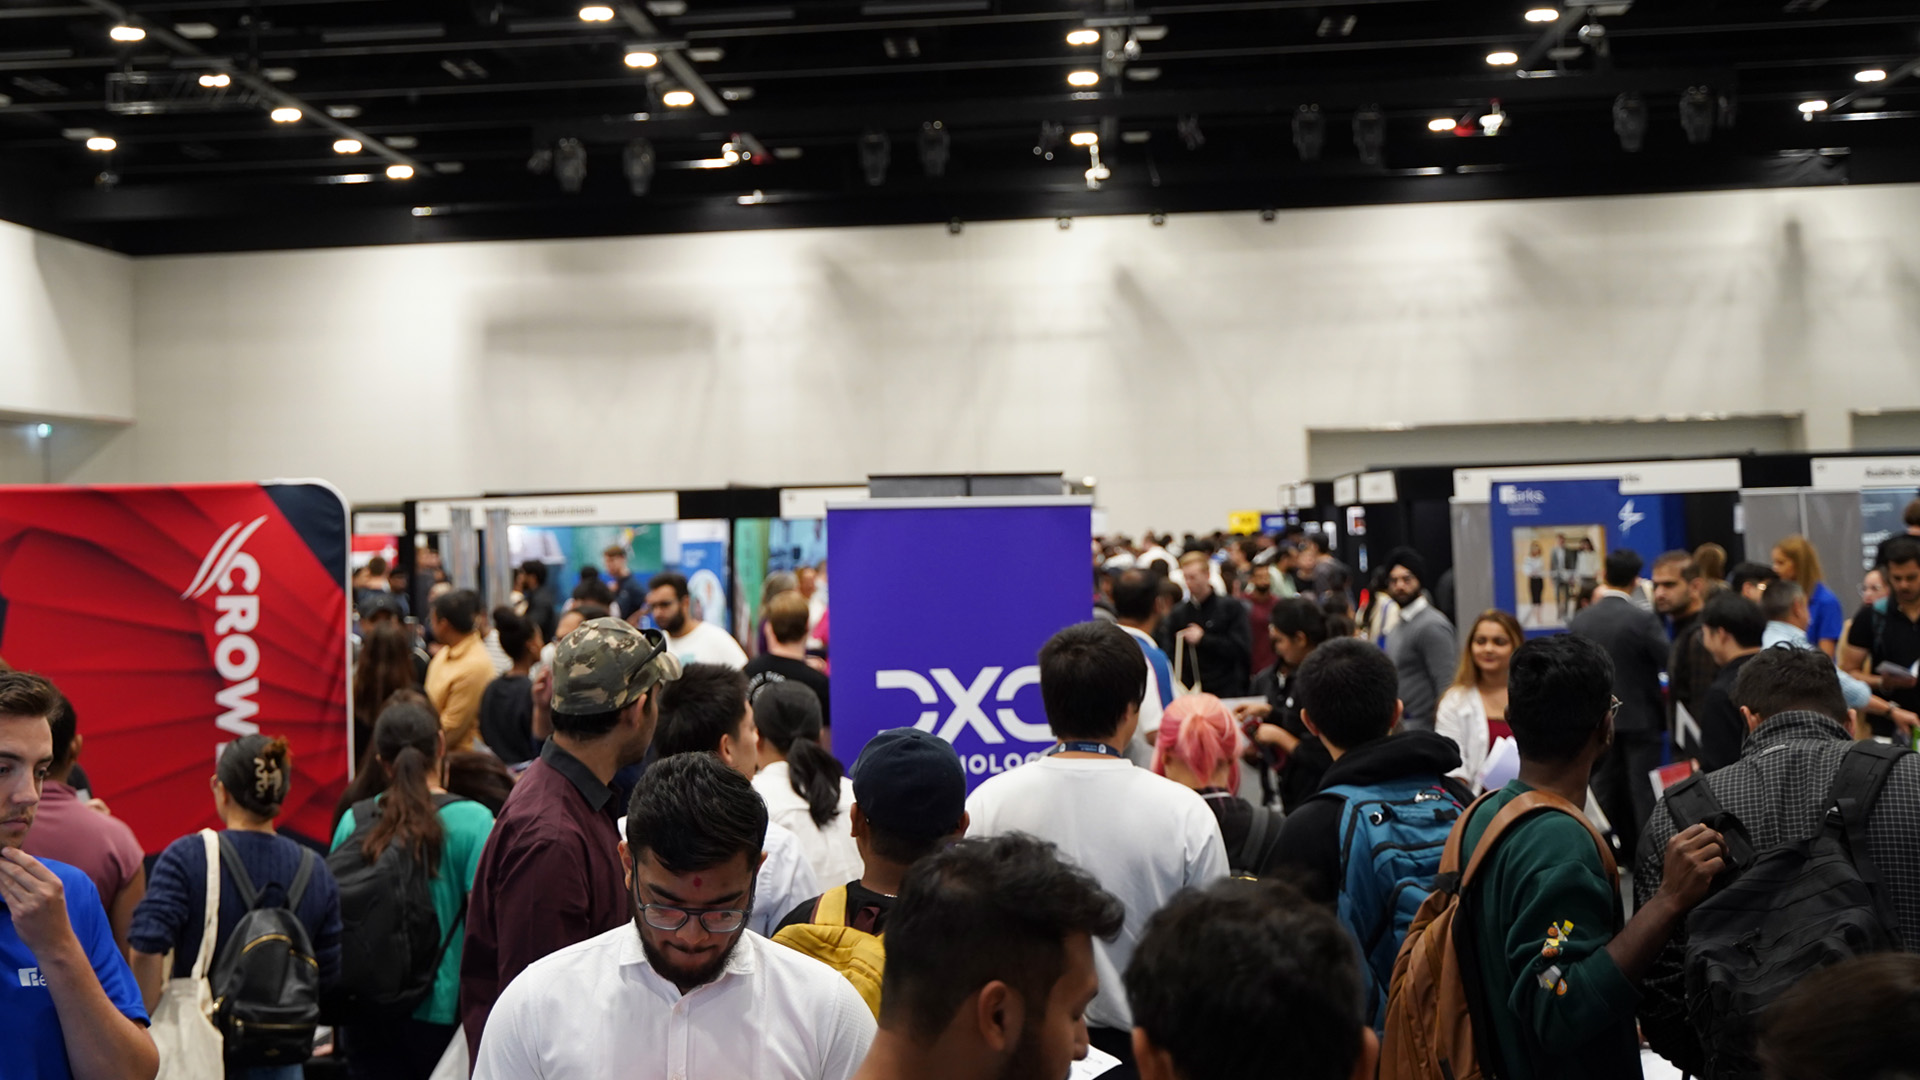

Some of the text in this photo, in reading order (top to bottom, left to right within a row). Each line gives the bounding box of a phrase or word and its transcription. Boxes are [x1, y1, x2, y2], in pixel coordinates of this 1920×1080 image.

[214, 551, 261, 768] CROW
[876, 665, 1057, 744] DXC
[959, 752, 1042, 775] OLO
